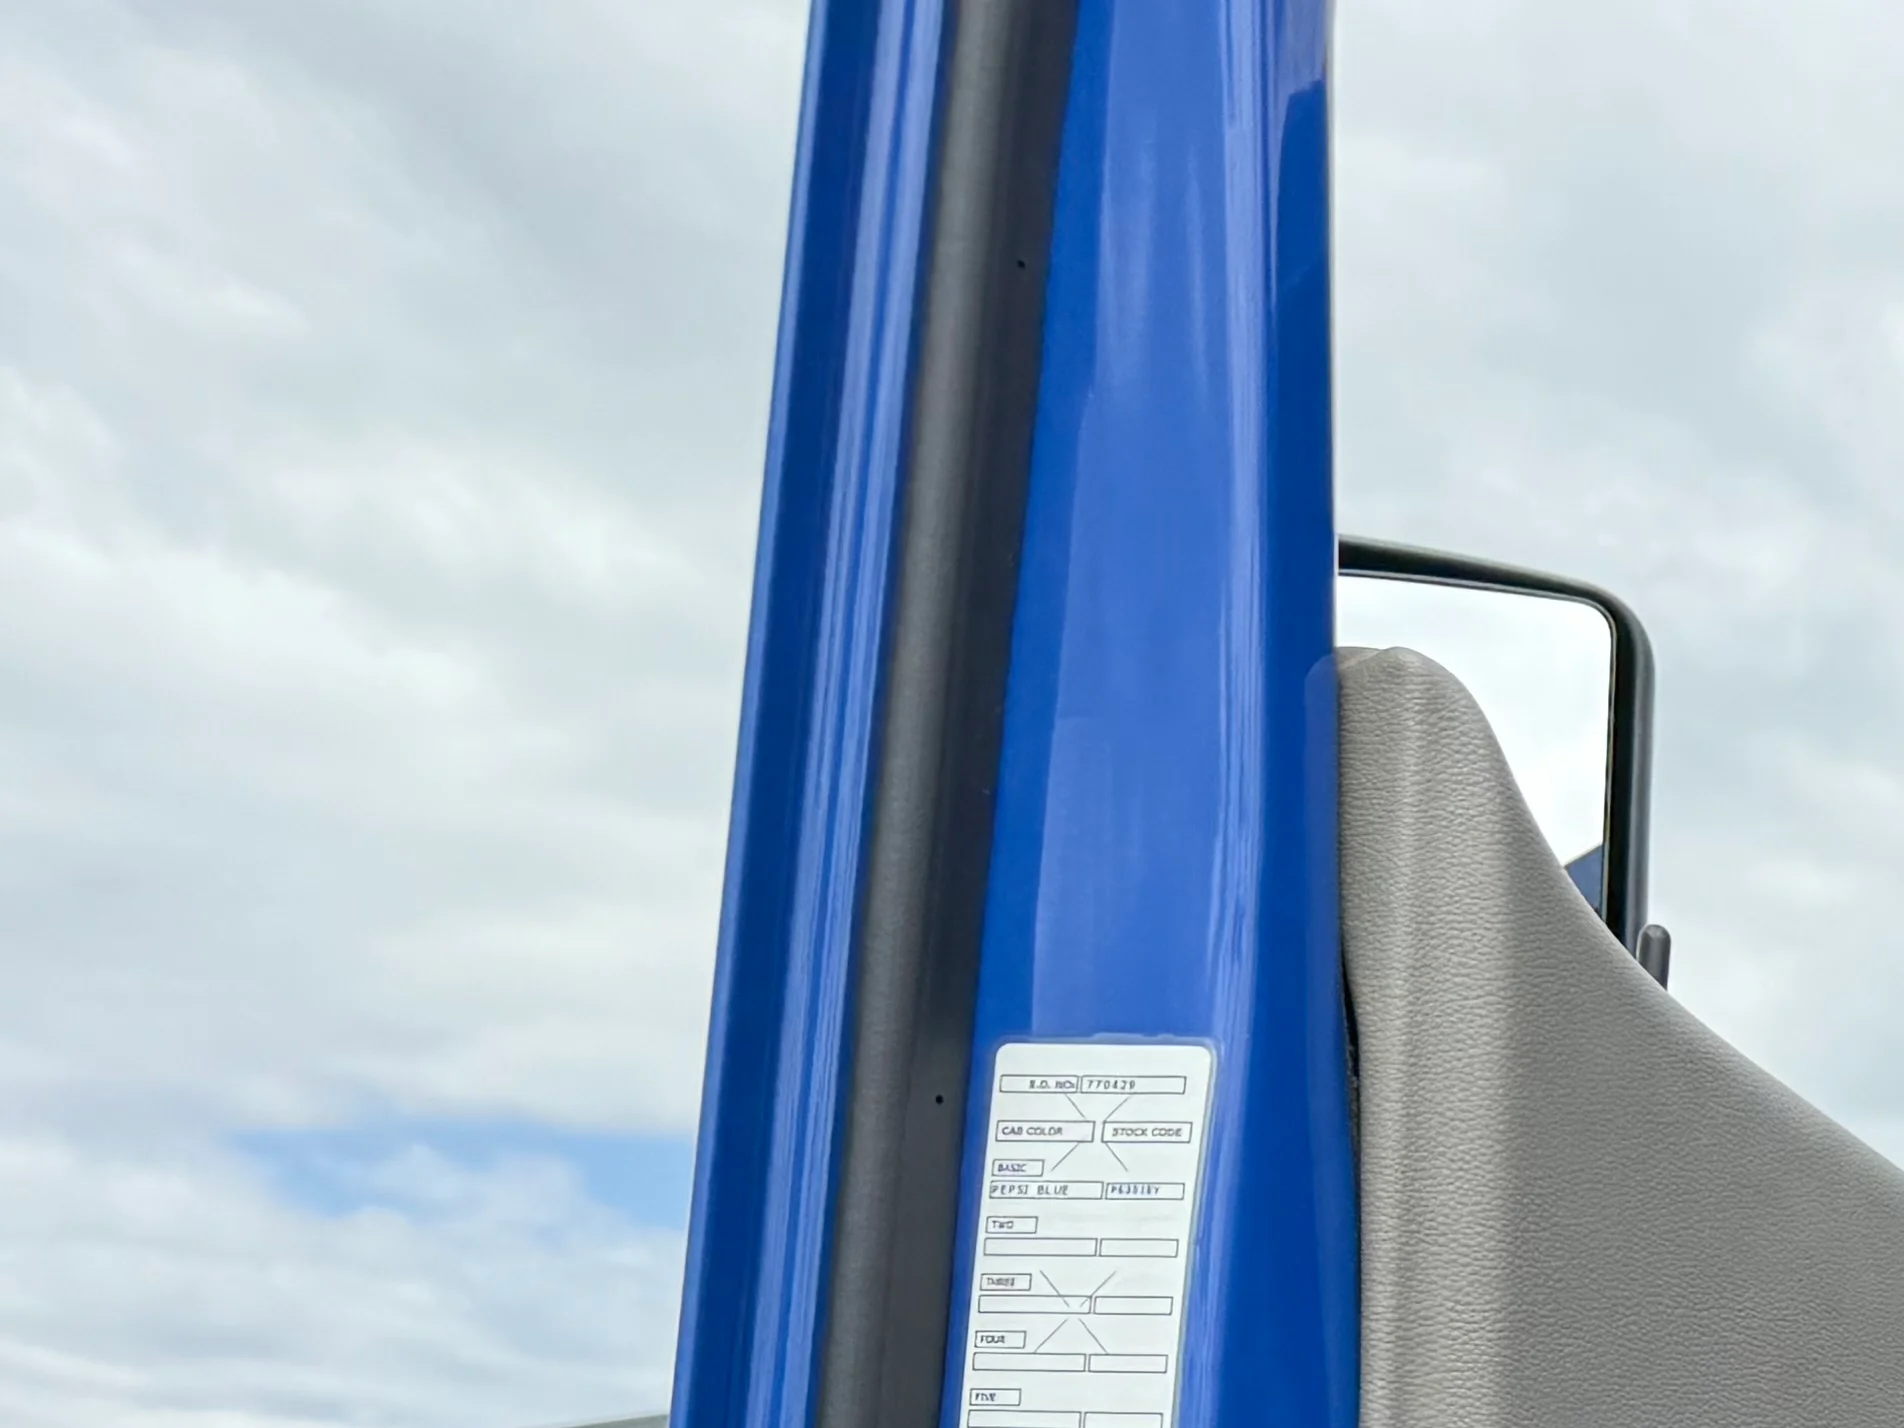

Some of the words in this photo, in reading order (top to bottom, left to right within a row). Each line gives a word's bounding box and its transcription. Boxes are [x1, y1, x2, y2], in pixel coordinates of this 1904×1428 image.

[1087, 1079, 1136, 1090] 770429
[1001, 1126, 1023, 1136] CAB
[1026, 1126, 1063, 1136] COLOR
[1111, 1127, 1148, 1137] STOCK
[1152, 1128, 1182, 1137] CODE
[998, 1163, 1027, 1173] BASIC
[990, 1185, 1029, 1195] PEPSI
[1037, 1185, 1068, 1195] BLUE
[992, 1220, 1014, 1229] TWO
[980, 1335, 1005, 1344] FOUR
